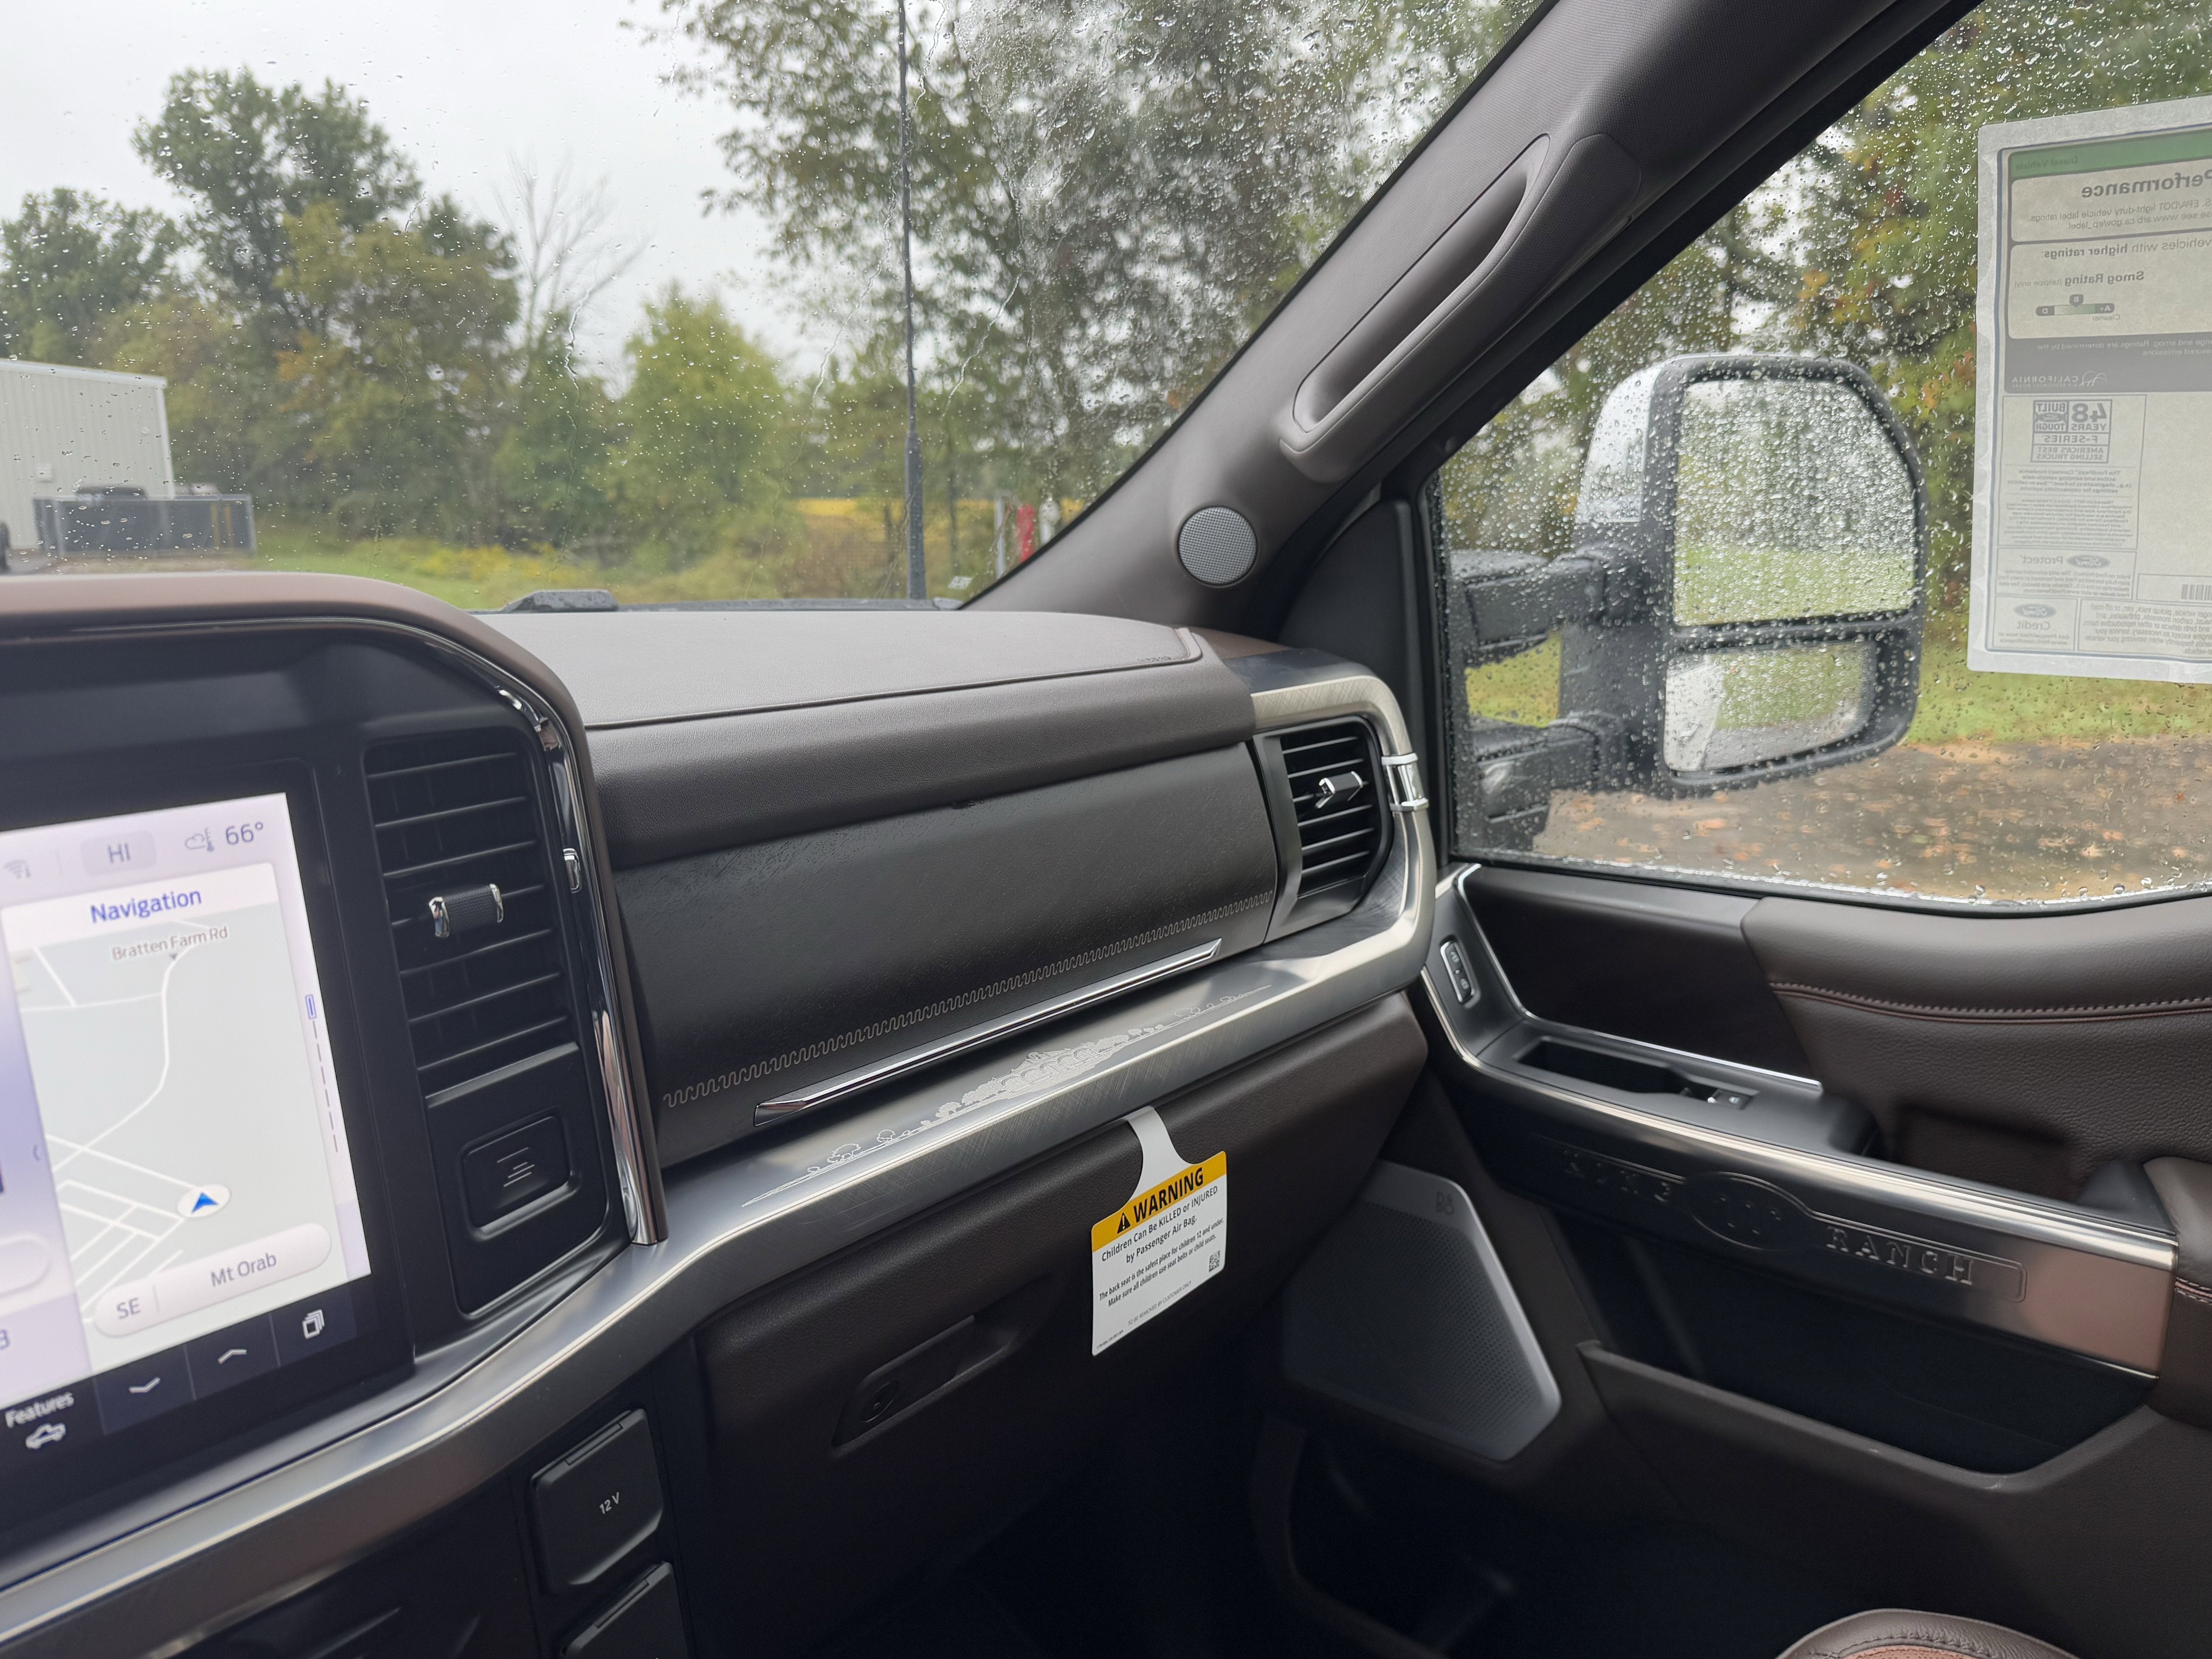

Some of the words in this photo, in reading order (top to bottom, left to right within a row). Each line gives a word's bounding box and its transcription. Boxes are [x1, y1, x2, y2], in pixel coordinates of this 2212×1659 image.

[225, 821, 264, 846] 66°
[108, 843, 131, 865] HI
[90, 888, 202, 924] Navigation
[112, 935, 169, 961] Bratten
[171, 931, 208, 949] Farm
[210, 926, 228, 941] Rd
[1133, 1167, 1203, 1223] WARNING
[1102, 1239, 1132, 1261] Children
[1133, 1230, 1147, 1242] Can
[1149, 1224, 1157, 1233] Be
[1159, 1207, 1182, 1228] KILLED
[1183, 1203, 1190, 1212] or
[1192, 1185, 1218, 1207] INJURED
[1126, 1253, 1134, 1263] by
[1136, 1230, 1171, 1257] Passenger
[1172, 1223, 1182, 1235] Air
[1183, 1215, 1197, 1228] Bag.
[211, 1267, 235, 1288] Mt
[237, 1252, 277, 1278] Orab
[1099, 1291, 1108, 1301] The
[1109, 1283, 1120, 1294] back
[1121, 1276, 1131, 1287] seat
[1145, 1259, 1158, 1272] safest
[1159, 1251, 1170, 1265] place
[1178, 1235, 1195, 1251] children
[1211, 1218, 1224, 1230] under.
[1108, 1295, 1121, 1307] Make
[1122, 1288, 1132, 1298] sure
[1140, 1271, 1158, 1286] children
[1158, 1266, 1166, 1274] use
[1167, 1259, 1177, 1269] seat
[1177, 1252, 1188, 1263] belts
[1194, 1240, 1204, 1252] child
[1205, 1233, 1216, 1245] seats.
[1825, 1226, 1974, 1286] RANCH
[116, 1298, 142, 1320] SE
[5, 1391, 74, 1428] Features
[599, 1499, 612, 1515] 12
[611, 1492, 620, 1504] V
